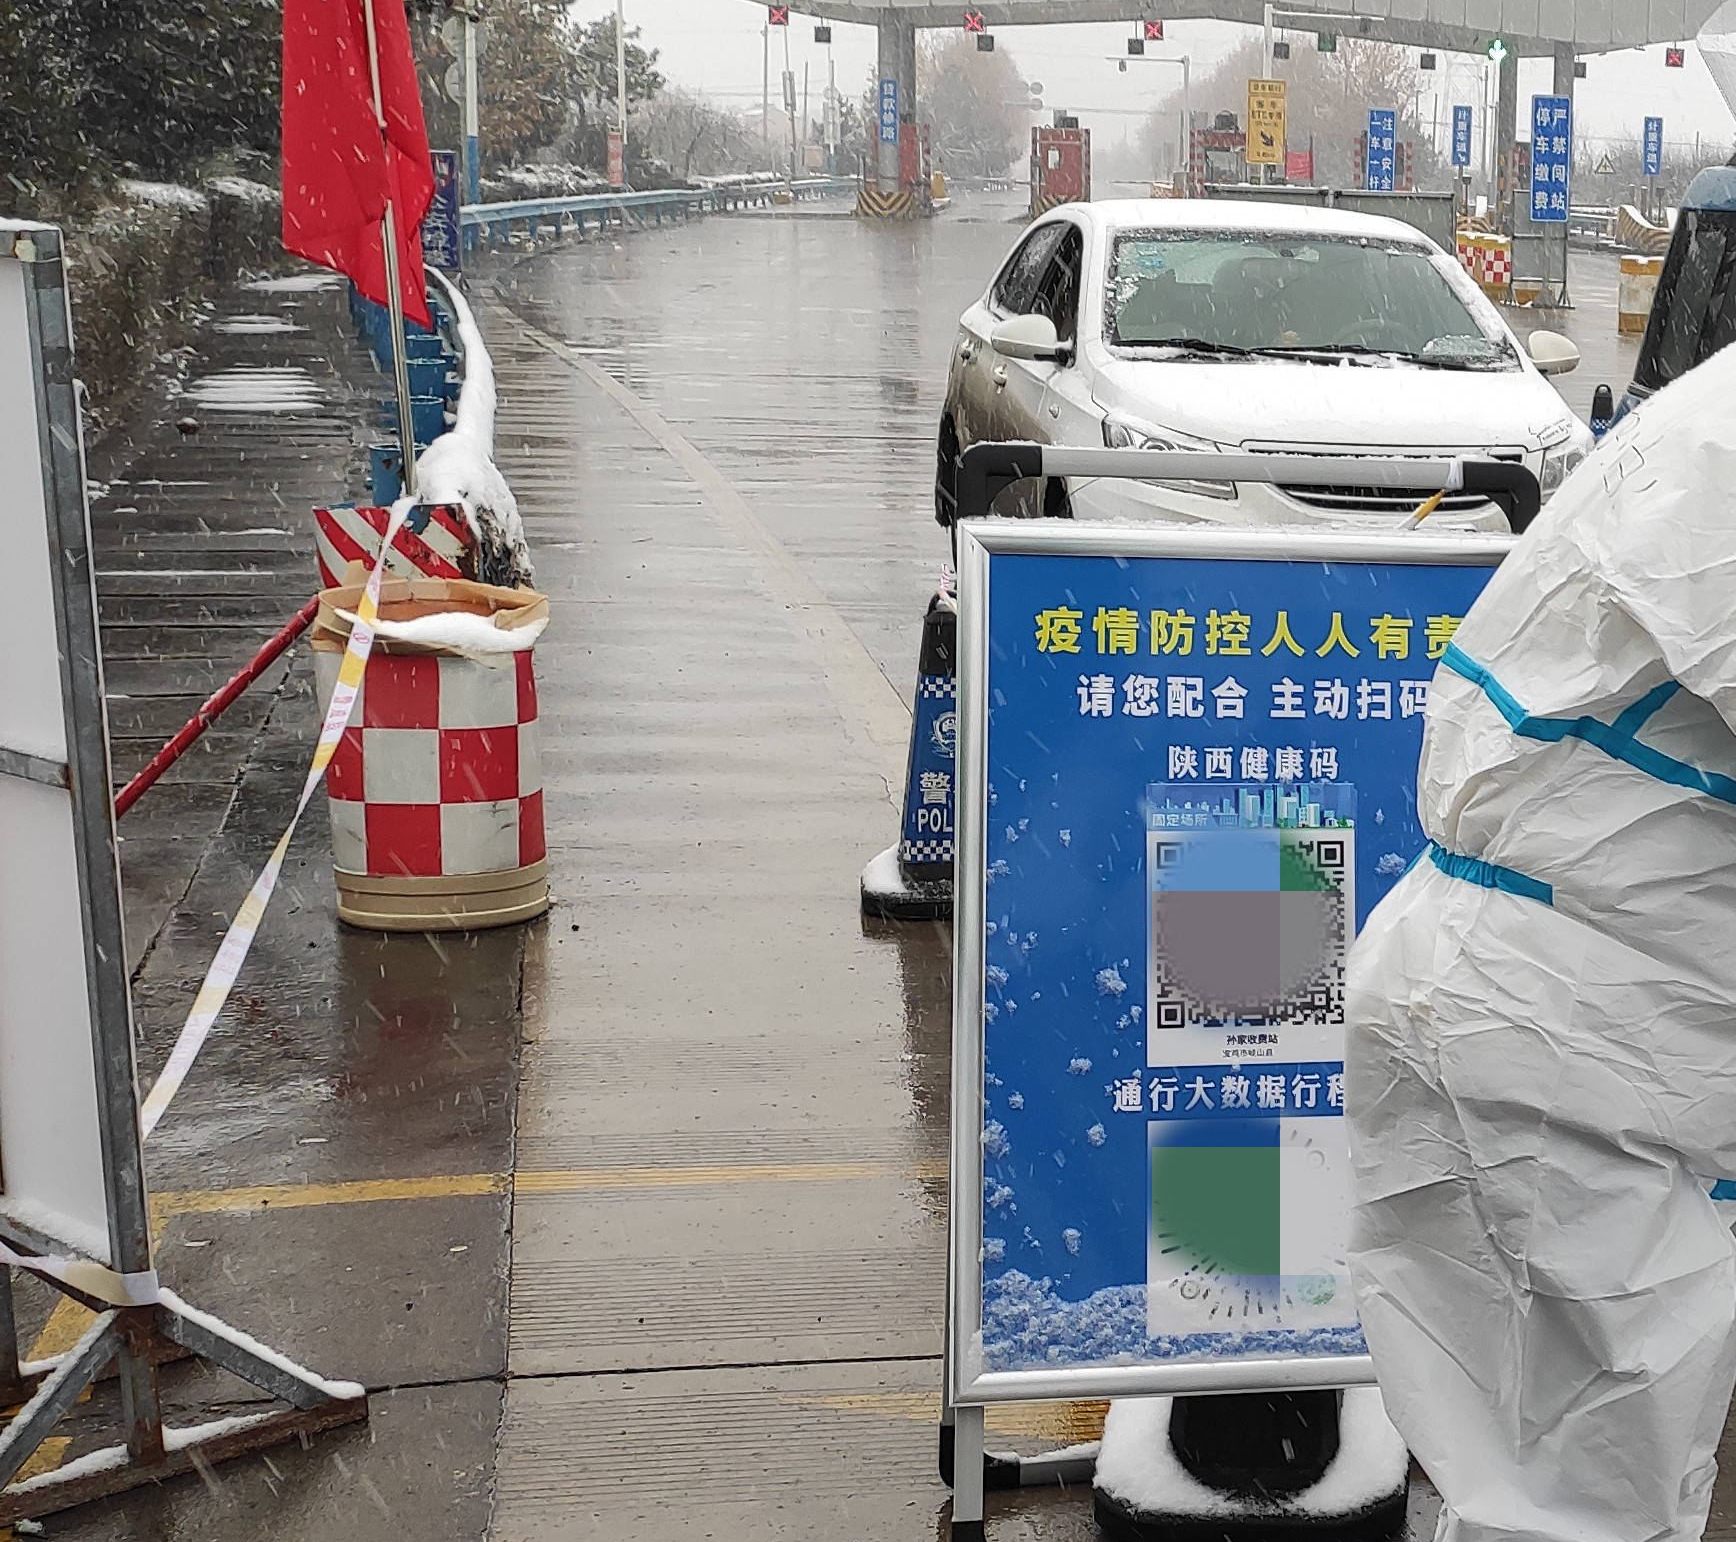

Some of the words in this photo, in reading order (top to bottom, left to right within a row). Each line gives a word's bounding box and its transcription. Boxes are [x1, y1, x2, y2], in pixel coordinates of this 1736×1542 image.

[1534, 106, 1551, 211] 停车缴费
[1550, 107, 1567, 211] 严禁闯站
[1034, 606, 1462, 660] 疫情防控人人有责
[1076, 674, 1250, 720] 请您配合
[1269, 676, 1432, 721] 主动扫码
[1167, 745, 1340, 780] 陕西健康码
[1113, 1073, 1344, 1113] 通行大数据行程
